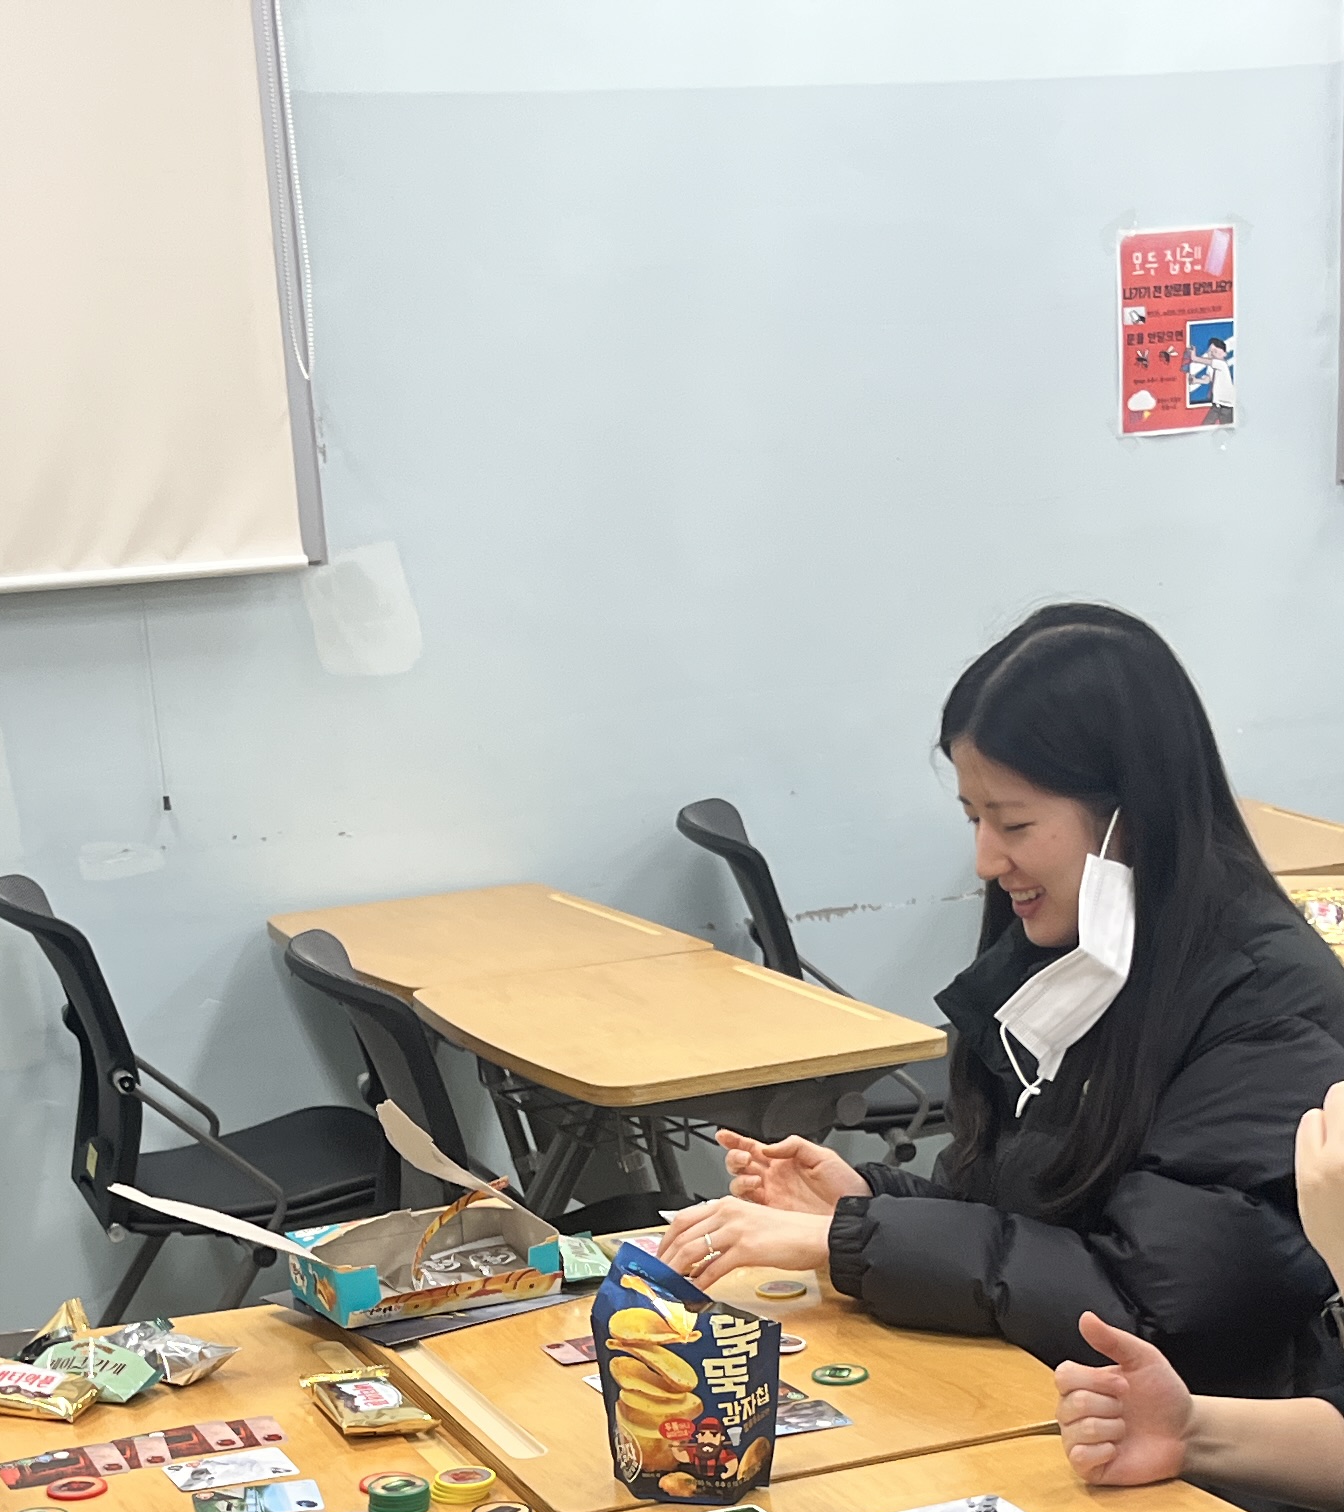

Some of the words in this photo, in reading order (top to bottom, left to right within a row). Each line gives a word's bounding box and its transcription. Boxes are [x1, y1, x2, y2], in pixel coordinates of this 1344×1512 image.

[1132, 251, 1159, 276] 모두
[1123, 286, 1151, 300] 나가기
[1153, 285, 1163, 299] 전
[1164, 283, 1192, 298] 창문을
[1126, 333, 1144, 346] 문을
[718, 1383, 770, 1427] 감자칩
